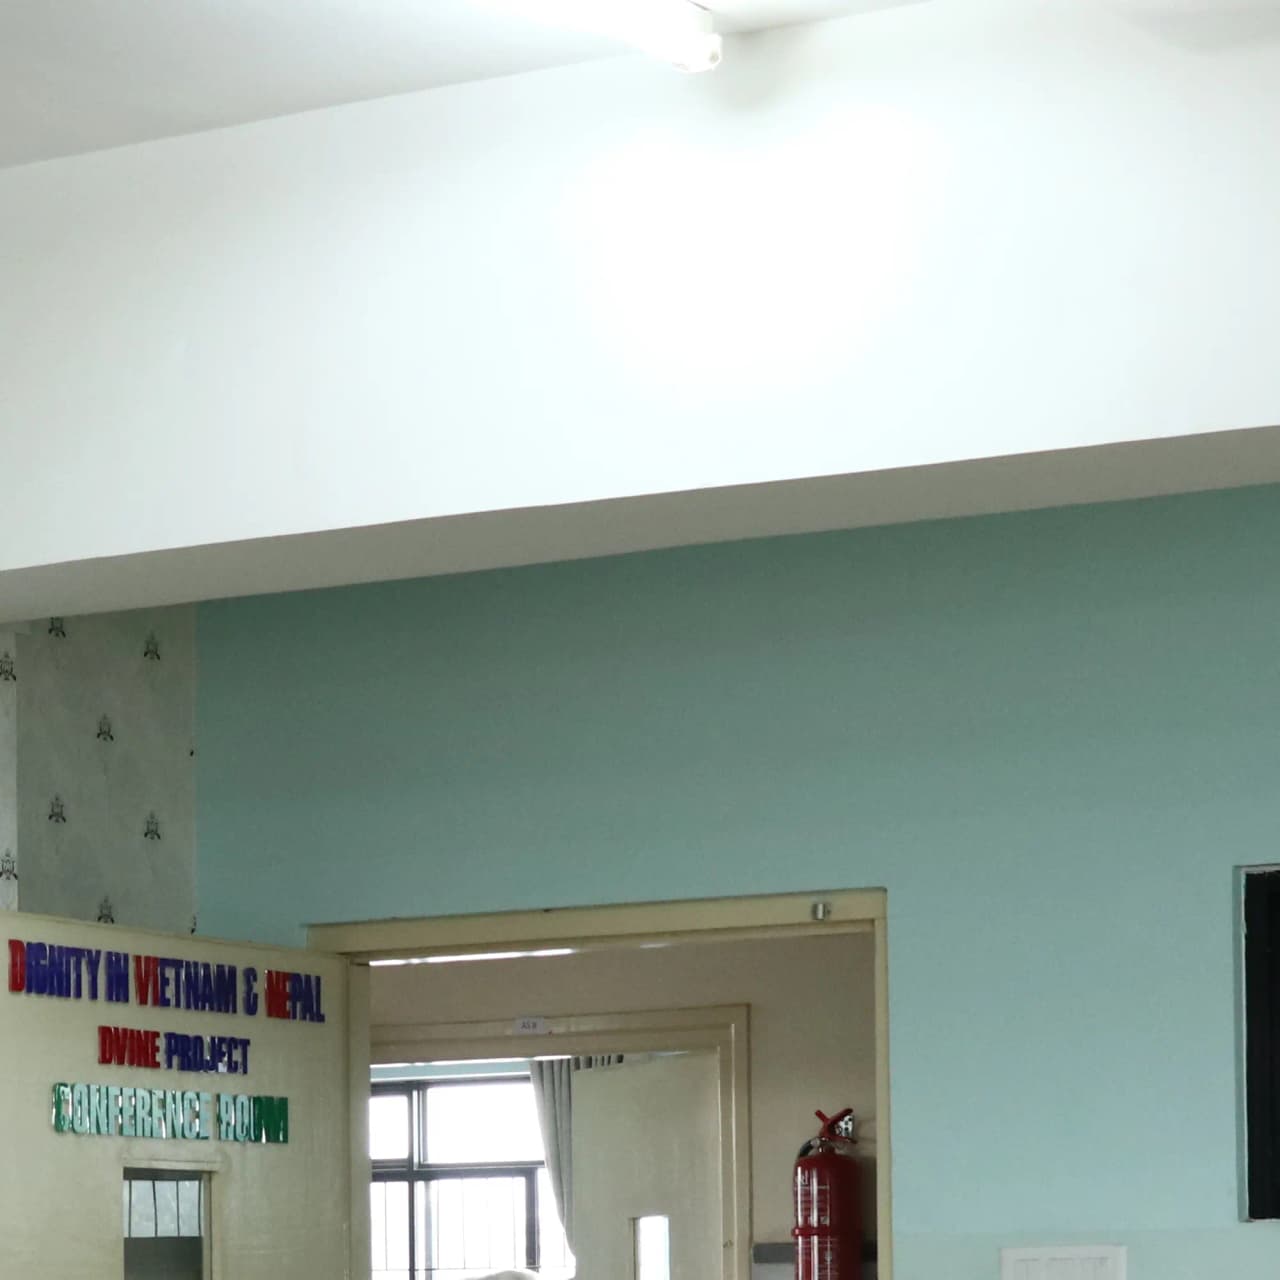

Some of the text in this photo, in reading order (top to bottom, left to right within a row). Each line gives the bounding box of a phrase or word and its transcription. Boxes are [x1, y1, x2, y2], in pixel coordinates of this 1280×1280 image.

[8, 939, 101, 1000] DIGNITY
[105, 951, 129, 1003] IN
[133, 955, 237, 1014] VIETNAM
[265, 969, 325, 1023] NEPAL
[97, 1026, 251, 1075] DVINE PROJECT
[51, 1082, 210, 1140] CONFERENCE
